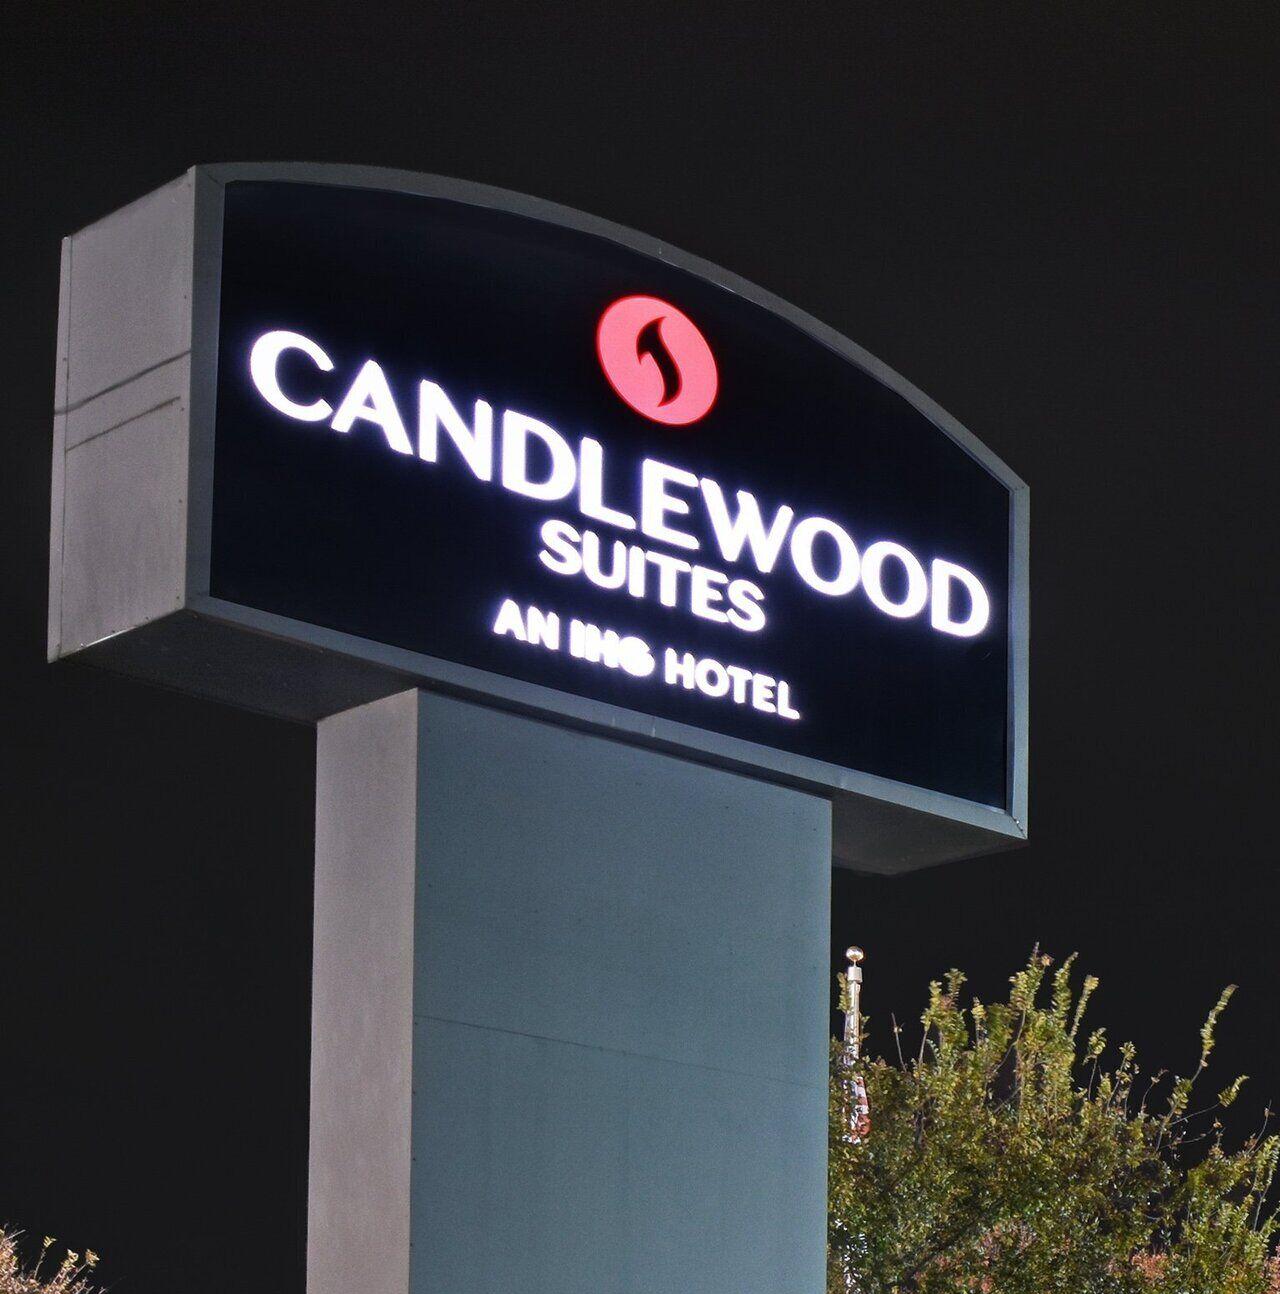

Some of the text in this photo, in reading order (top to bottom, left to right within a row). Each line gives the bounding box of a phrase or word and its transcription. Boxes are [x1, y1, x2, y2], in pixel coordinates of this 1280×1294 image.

[250, 331, 990, 637] CANDLEWOOD
[539, 520, 766, 631] SUITES
[493, 598, 560, 651] AN
[664, 647, 800, 720] HOTEL
